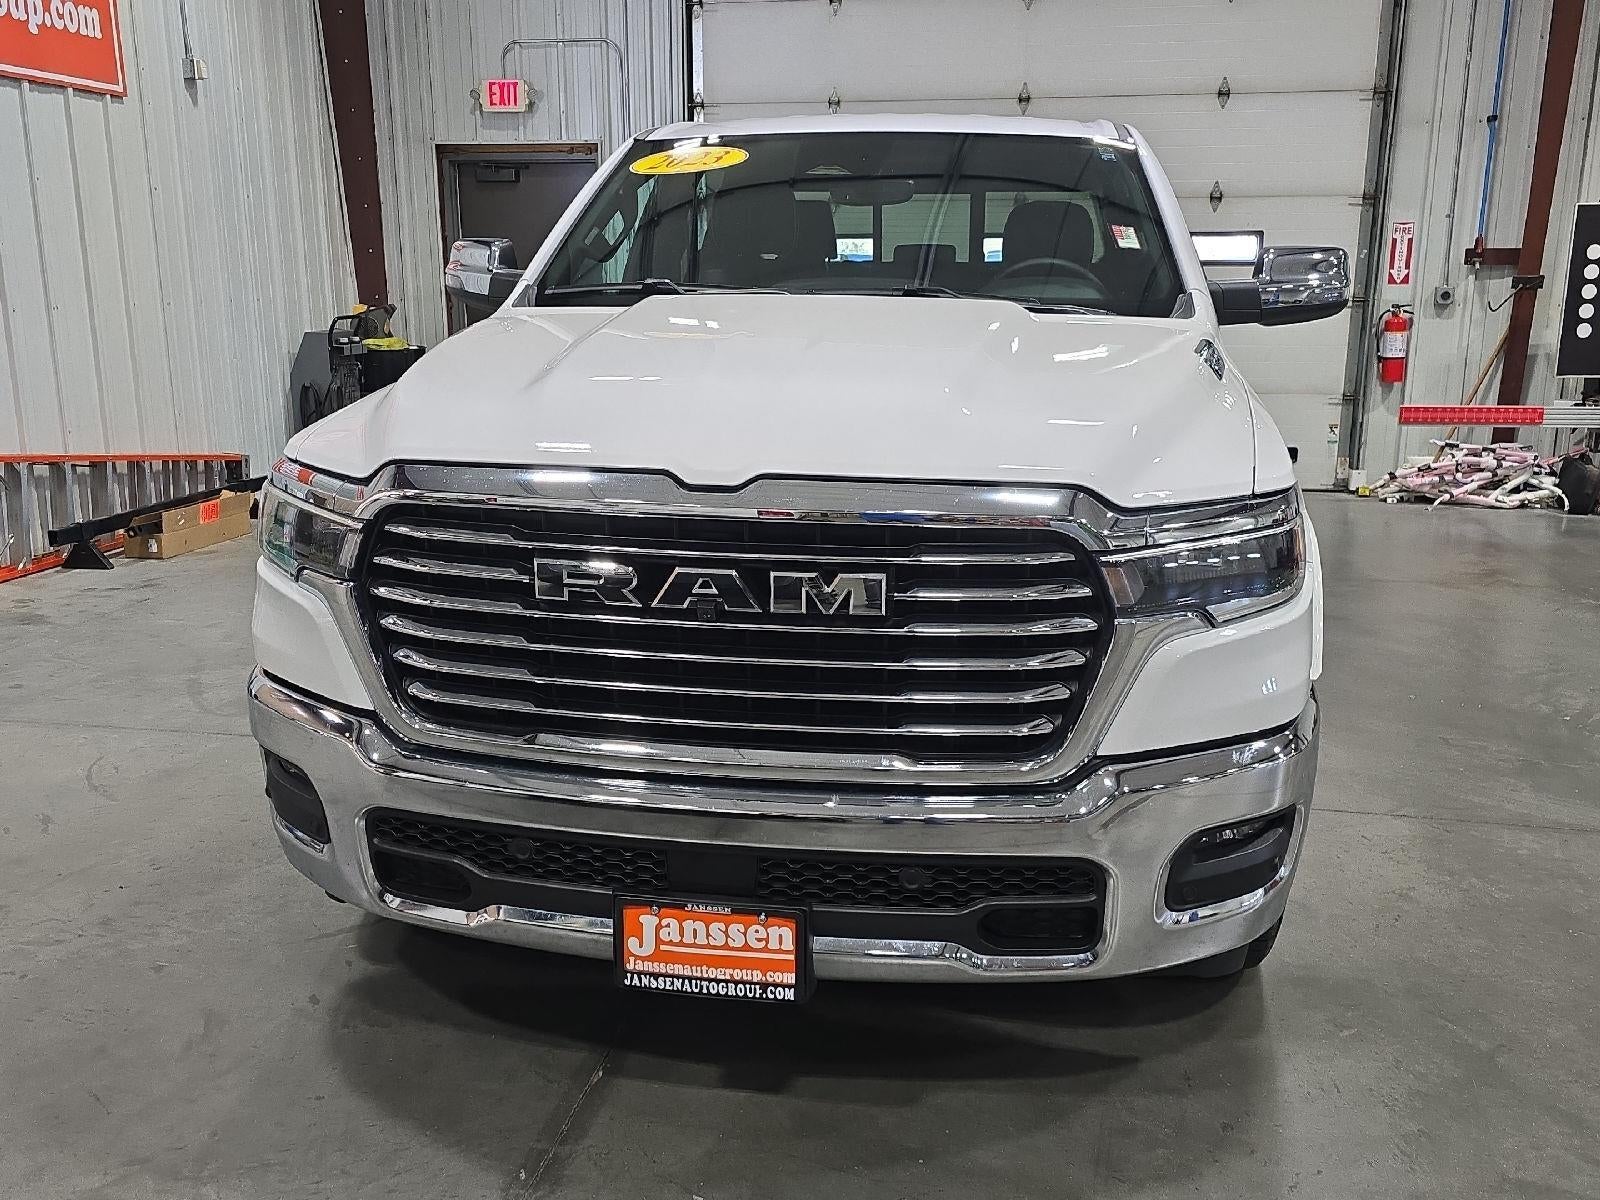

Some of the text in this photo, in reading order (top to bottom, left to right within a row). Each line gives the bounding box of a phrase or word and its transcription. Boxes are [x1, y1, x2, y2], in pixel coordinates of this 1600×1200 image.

[488, 82, 518, 106] EXIT
[1394, 226, 1413, 235] FIRE
[533, 557, 886, 616] RAM
[684, 903, 732, 914] JANSSEN
[627, 914, 795, 956] Janssen
[626, 957, 796, 986] Janssenautogroup.com
